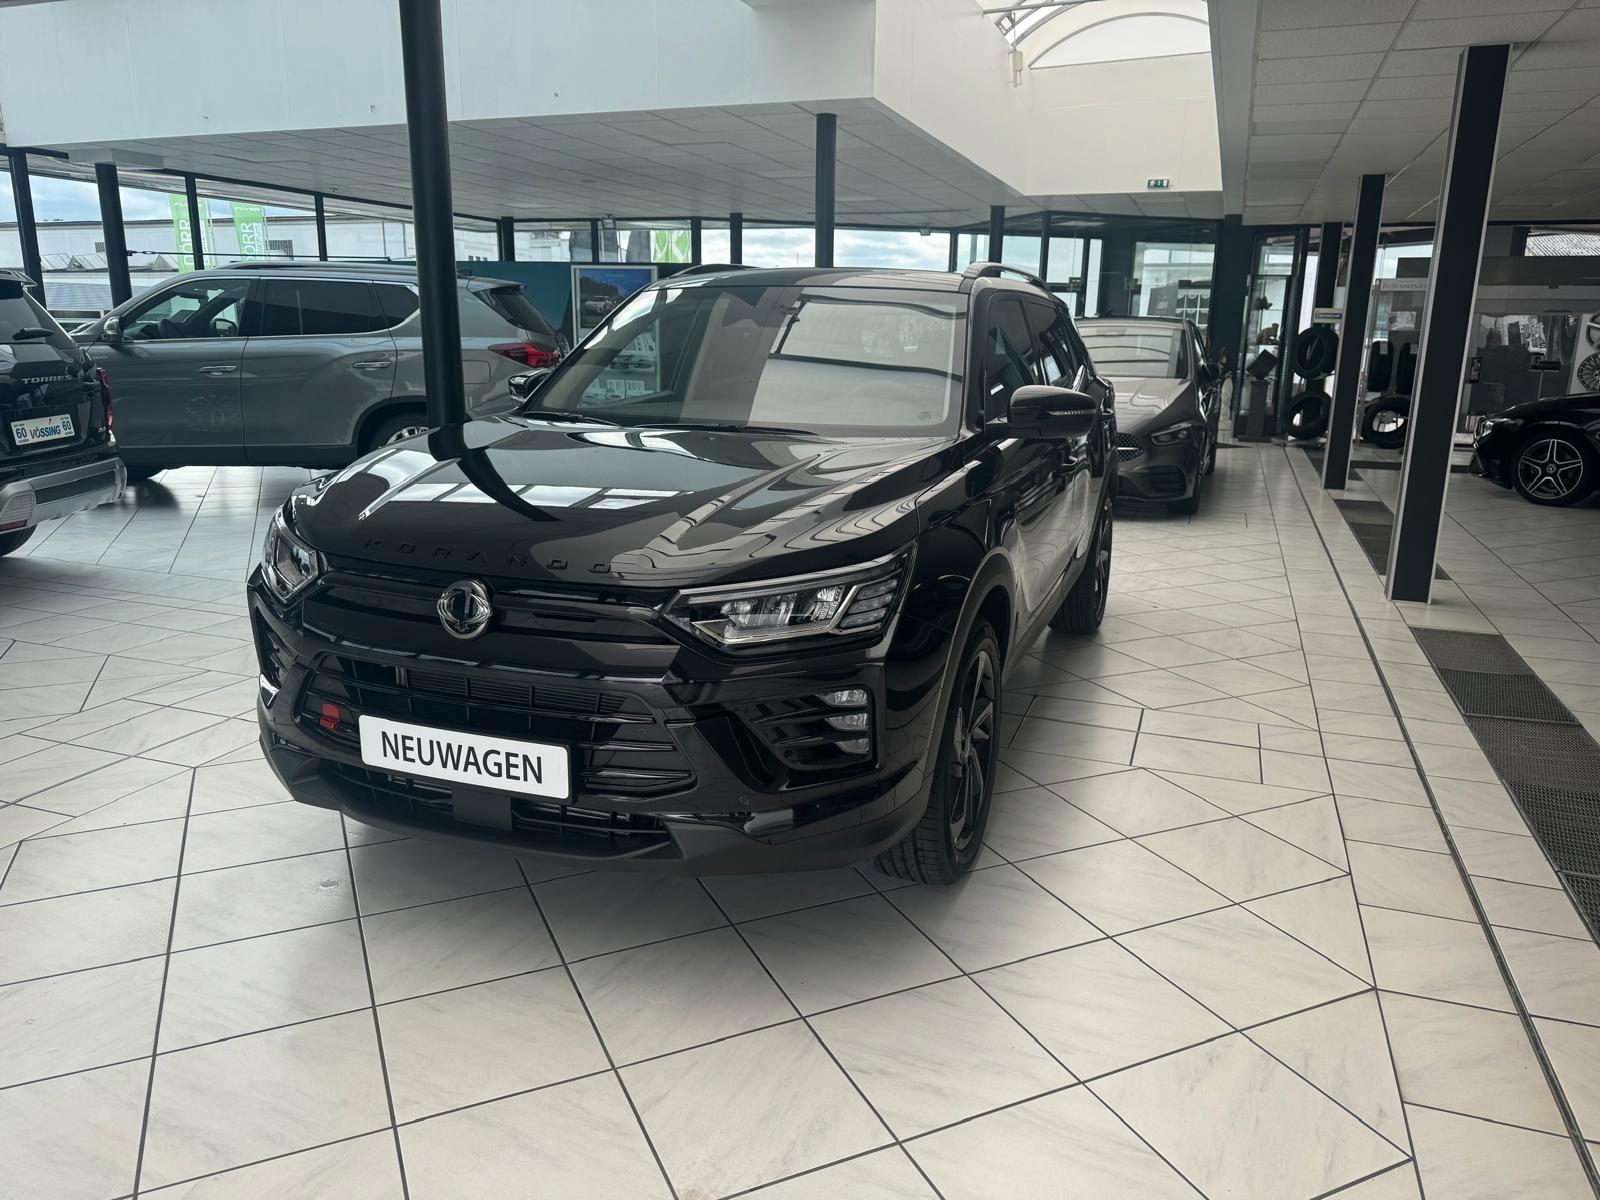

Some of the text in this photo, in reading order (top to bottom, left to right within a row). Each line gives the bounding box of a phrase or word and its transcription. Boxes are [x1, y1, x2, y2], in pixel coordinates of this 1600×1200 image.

[21, 374, 73, 385] TORRES
[15, 427, 27, 439] 60
[29, 425, 61, 440] VÖSSING
[61, 420, 72, 431] 60
[364, 537, 612, 575] KORANDO
[381, 730, 543, 784] NEUWAGEN
